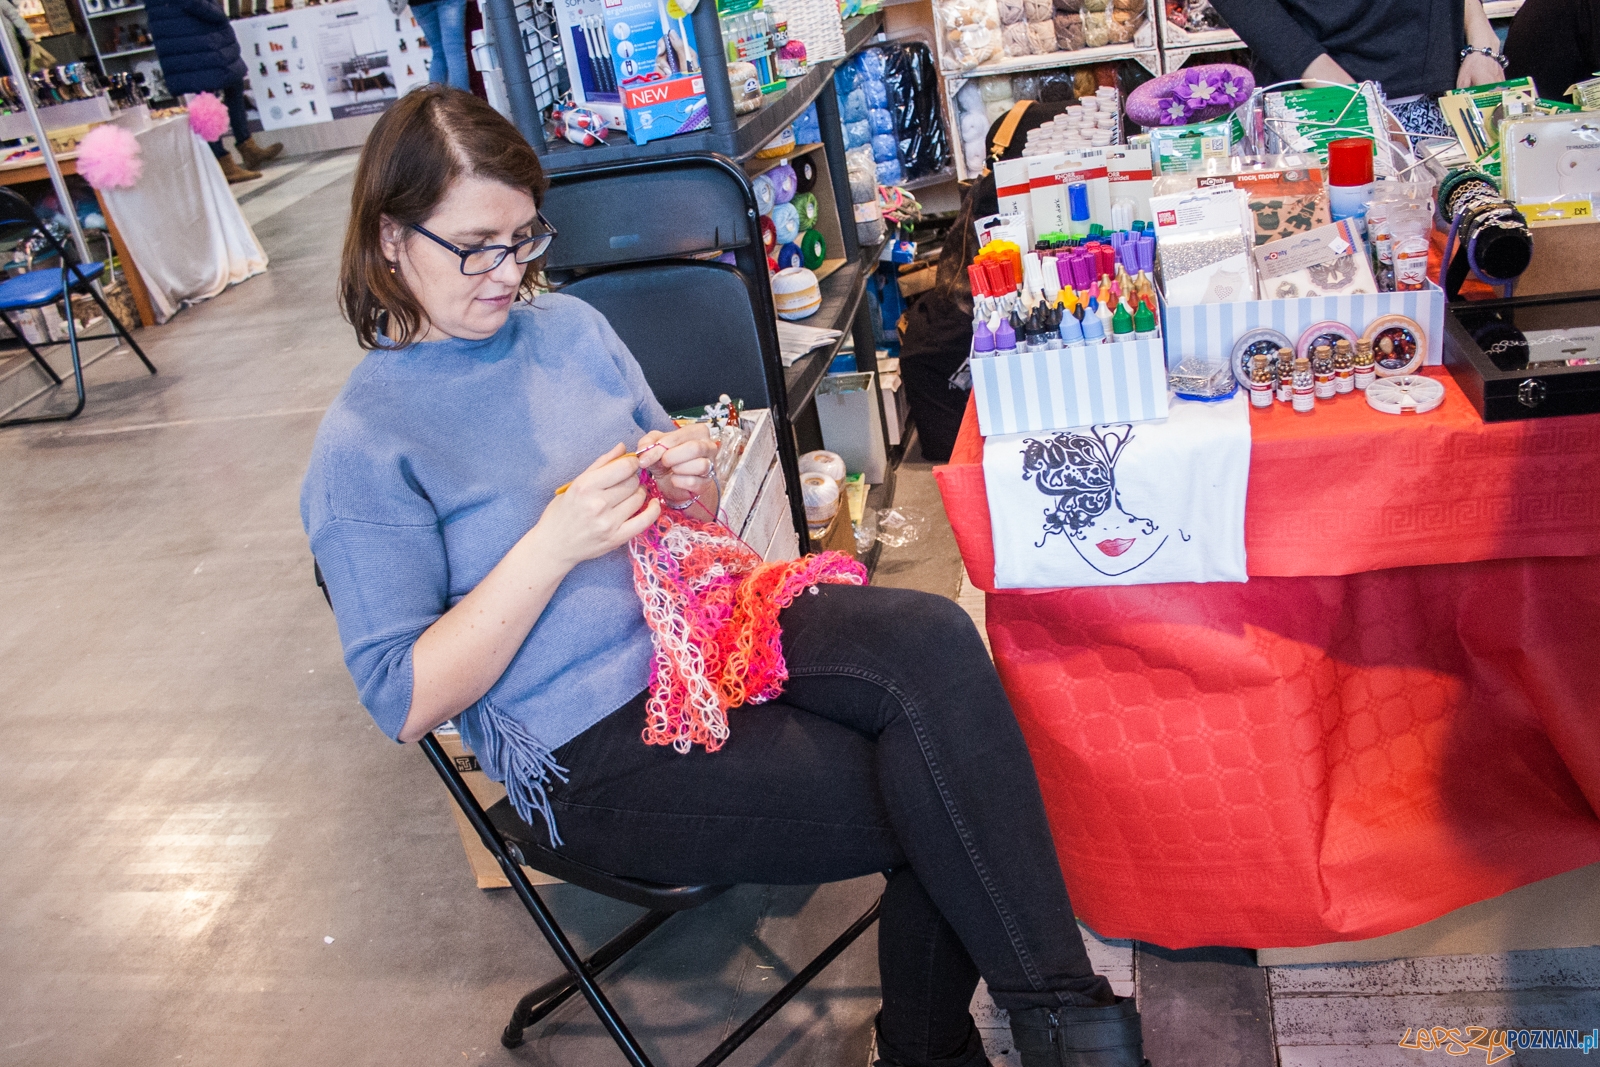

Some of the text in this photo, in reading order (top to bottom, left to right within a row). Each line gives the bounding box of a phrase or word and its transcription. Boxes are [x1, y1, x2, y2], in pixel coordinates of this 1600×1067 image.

[606, 2, 652, 16] ergonomics
[631, 86, 668, 106] NEW
[1574, 207, 1588, 216] BM
